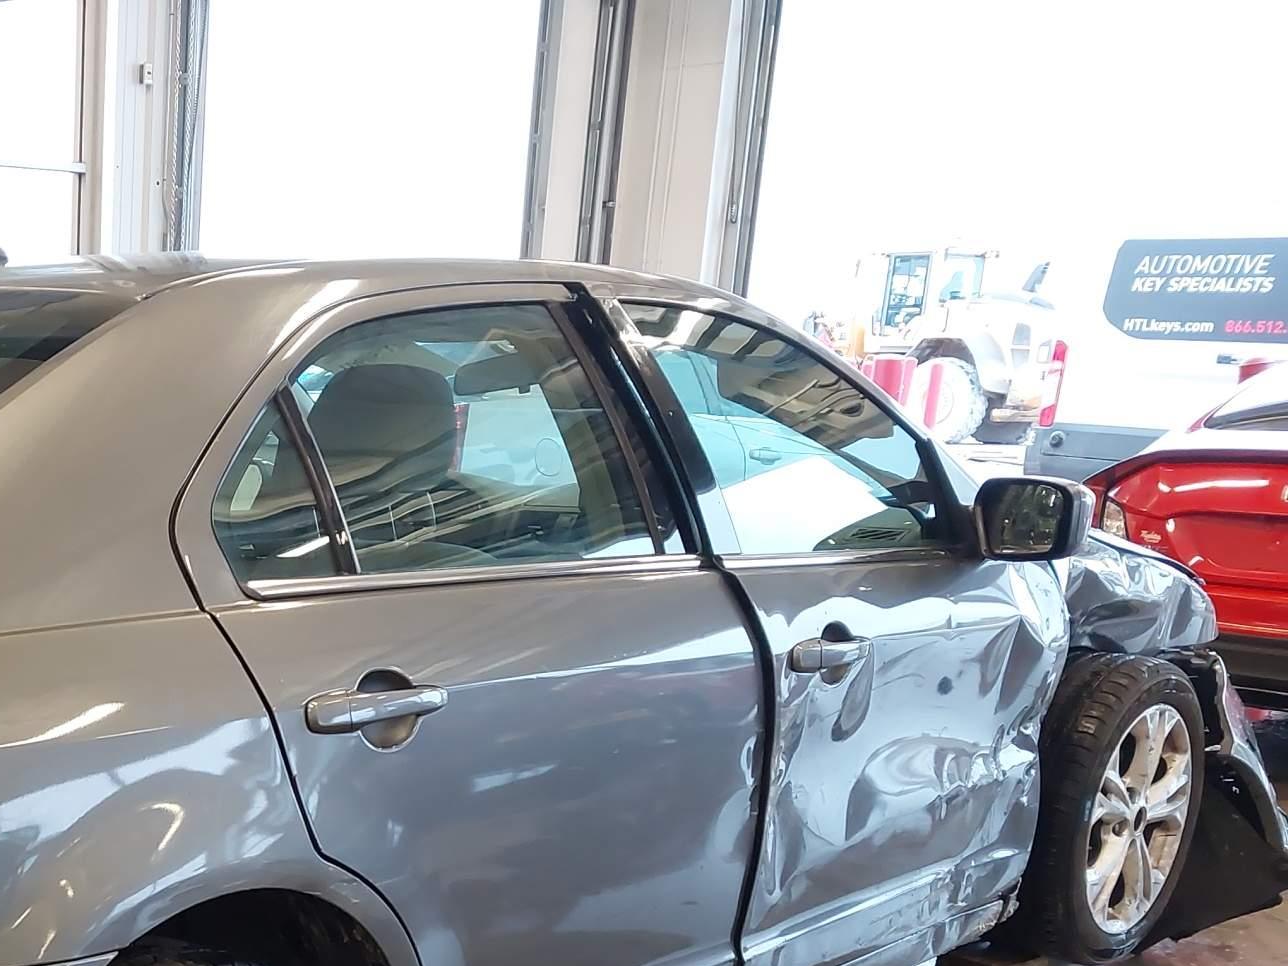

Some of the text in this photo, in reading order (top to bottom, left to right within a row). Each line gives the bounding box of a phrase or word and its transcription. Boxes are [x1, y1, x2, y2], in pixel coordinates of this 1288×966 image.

[1133, 253, 1275, 275] AUTOMOTIVE
[1130, 276, 1276, 294] KEY SPECIALISTS
[1123, 318, 1215, 335] HTLkeys.com
